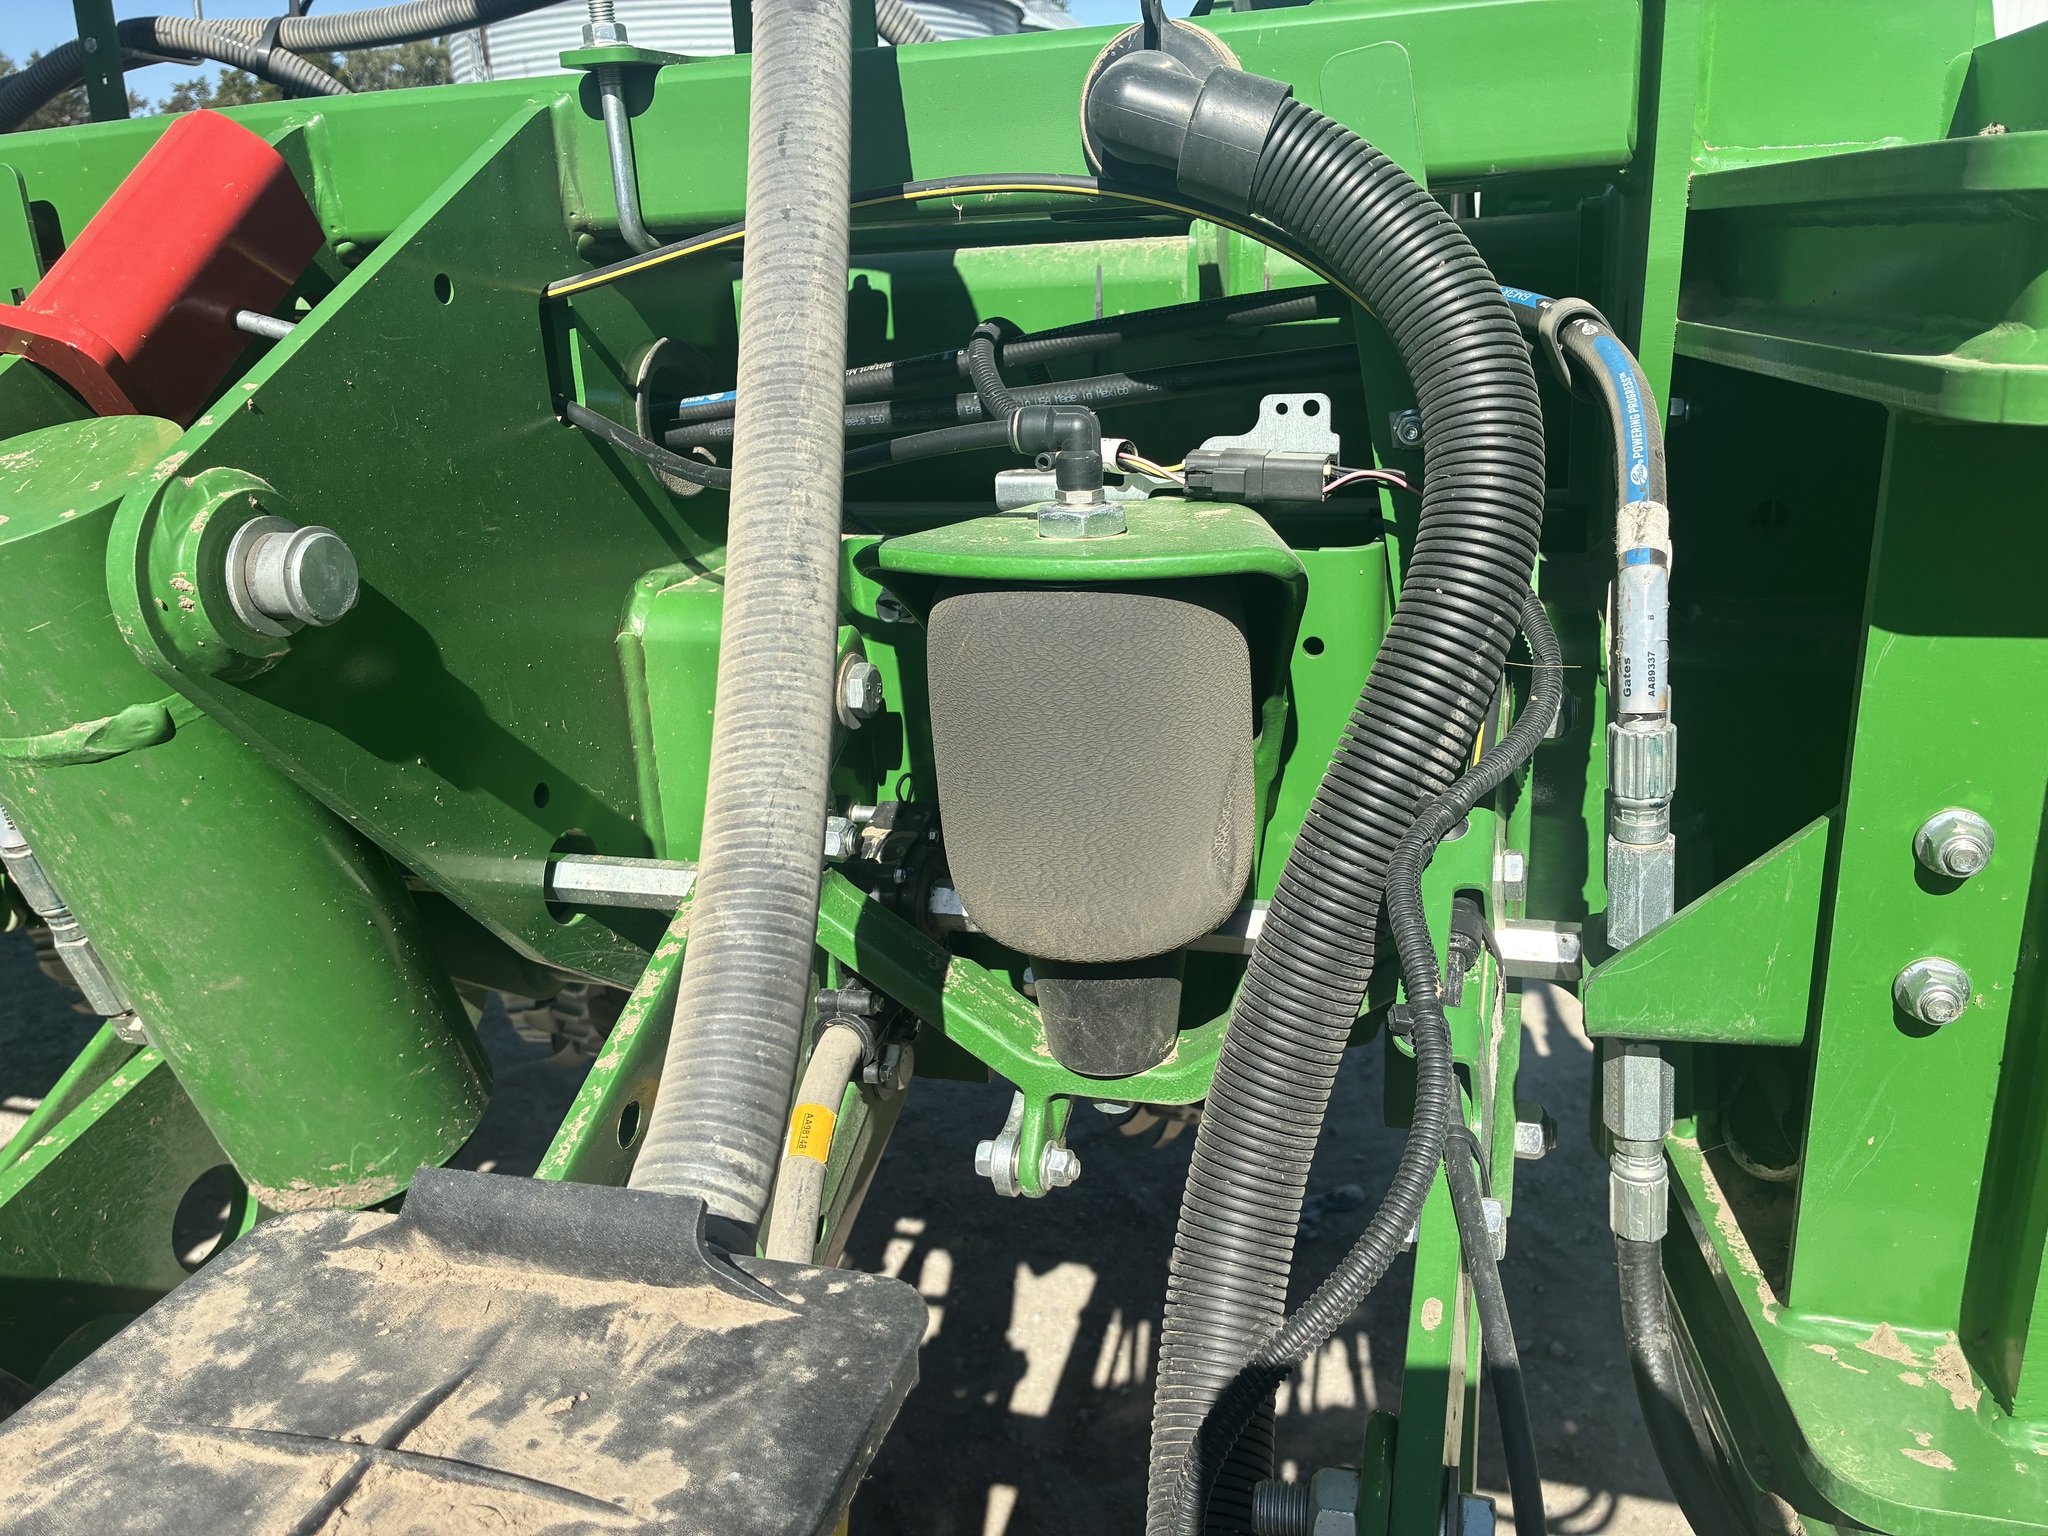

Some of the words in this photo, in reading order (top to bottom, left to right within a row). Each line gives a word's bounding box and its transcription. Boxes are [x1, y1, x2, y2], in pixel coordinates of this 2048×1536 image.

[1054, 394, 1078, 404] Made
[1097, 387, 1130, 399] Mexico
[1629, 413, 1645, 458] POWERING
[1622, 657, 1633, 698] Gates
[1647, 651, 1657, 698] AA89337
